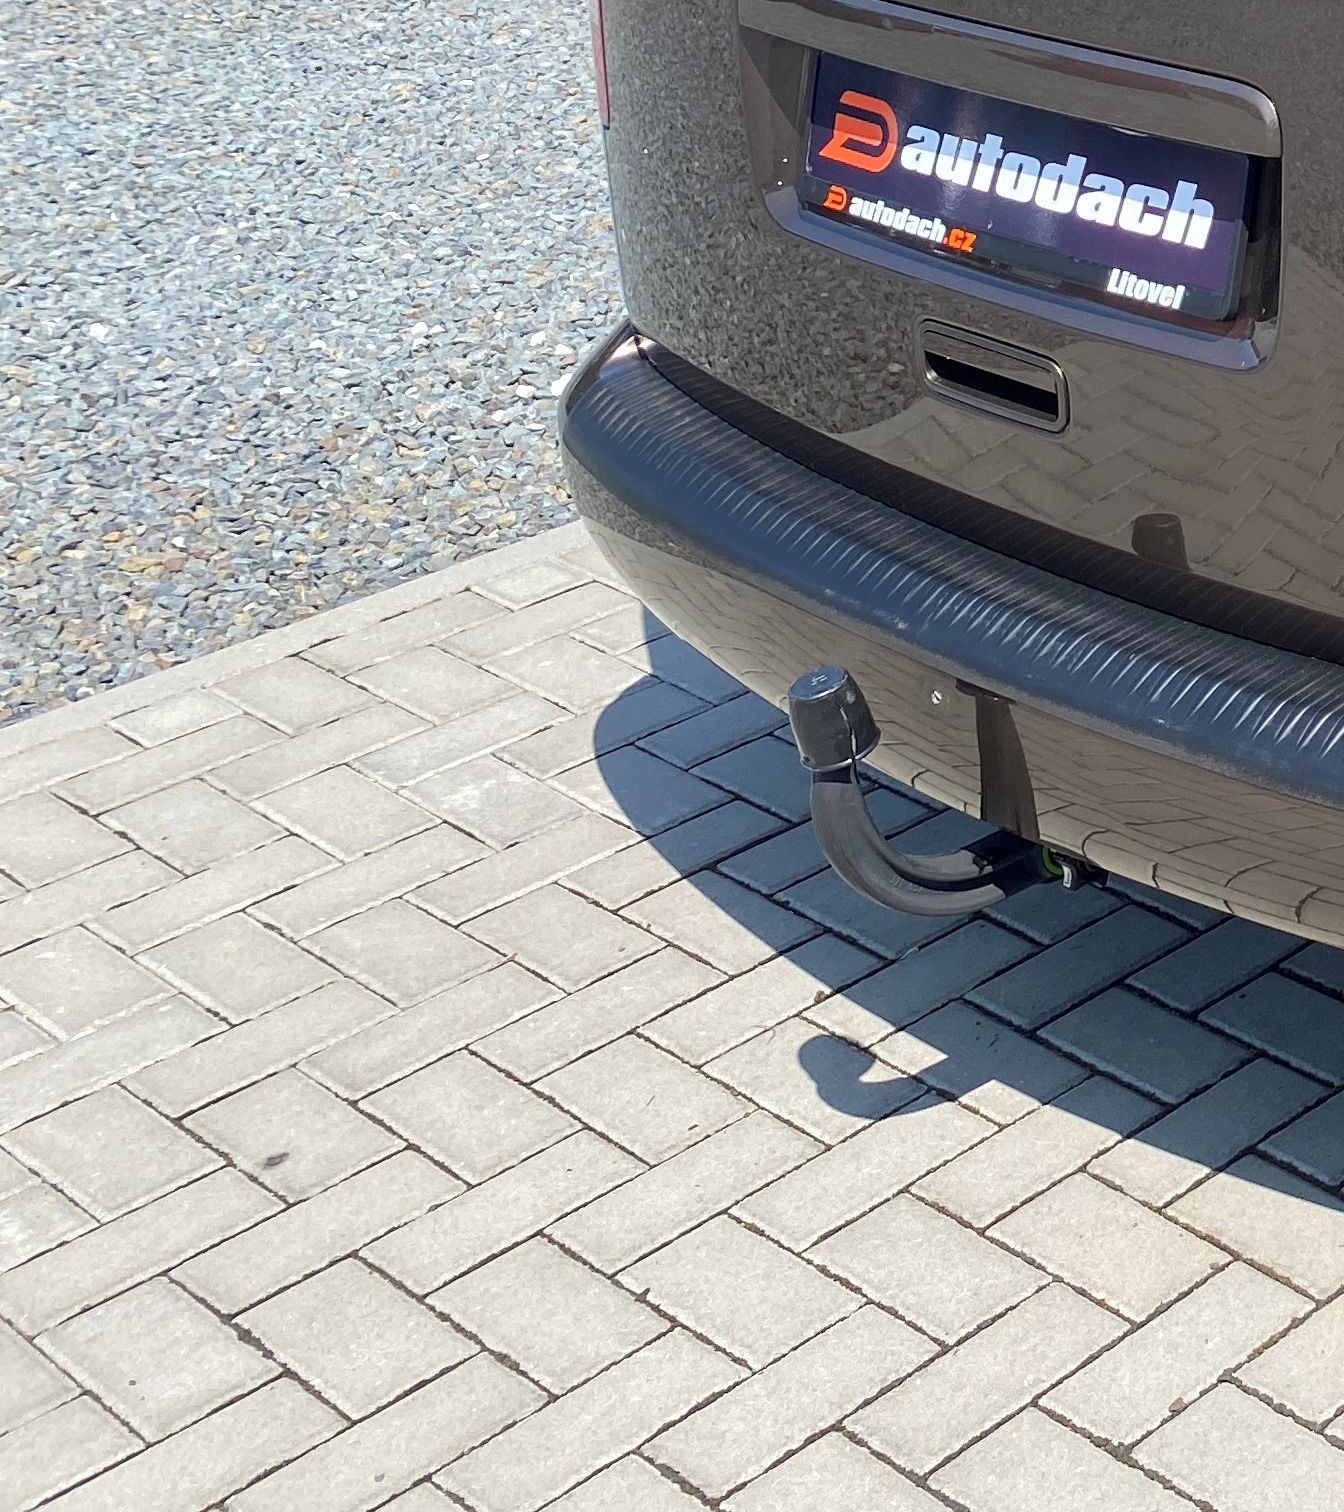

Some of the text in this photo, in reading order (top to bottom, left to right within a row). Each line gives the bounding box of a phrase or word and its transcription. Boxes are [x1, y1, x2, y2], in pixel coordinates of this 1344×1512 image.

[900, 124, 1215, 249] autodach
[848, 196, 977, 252] autodach.cz
[1106, 267, 1186, 310] Litovel
